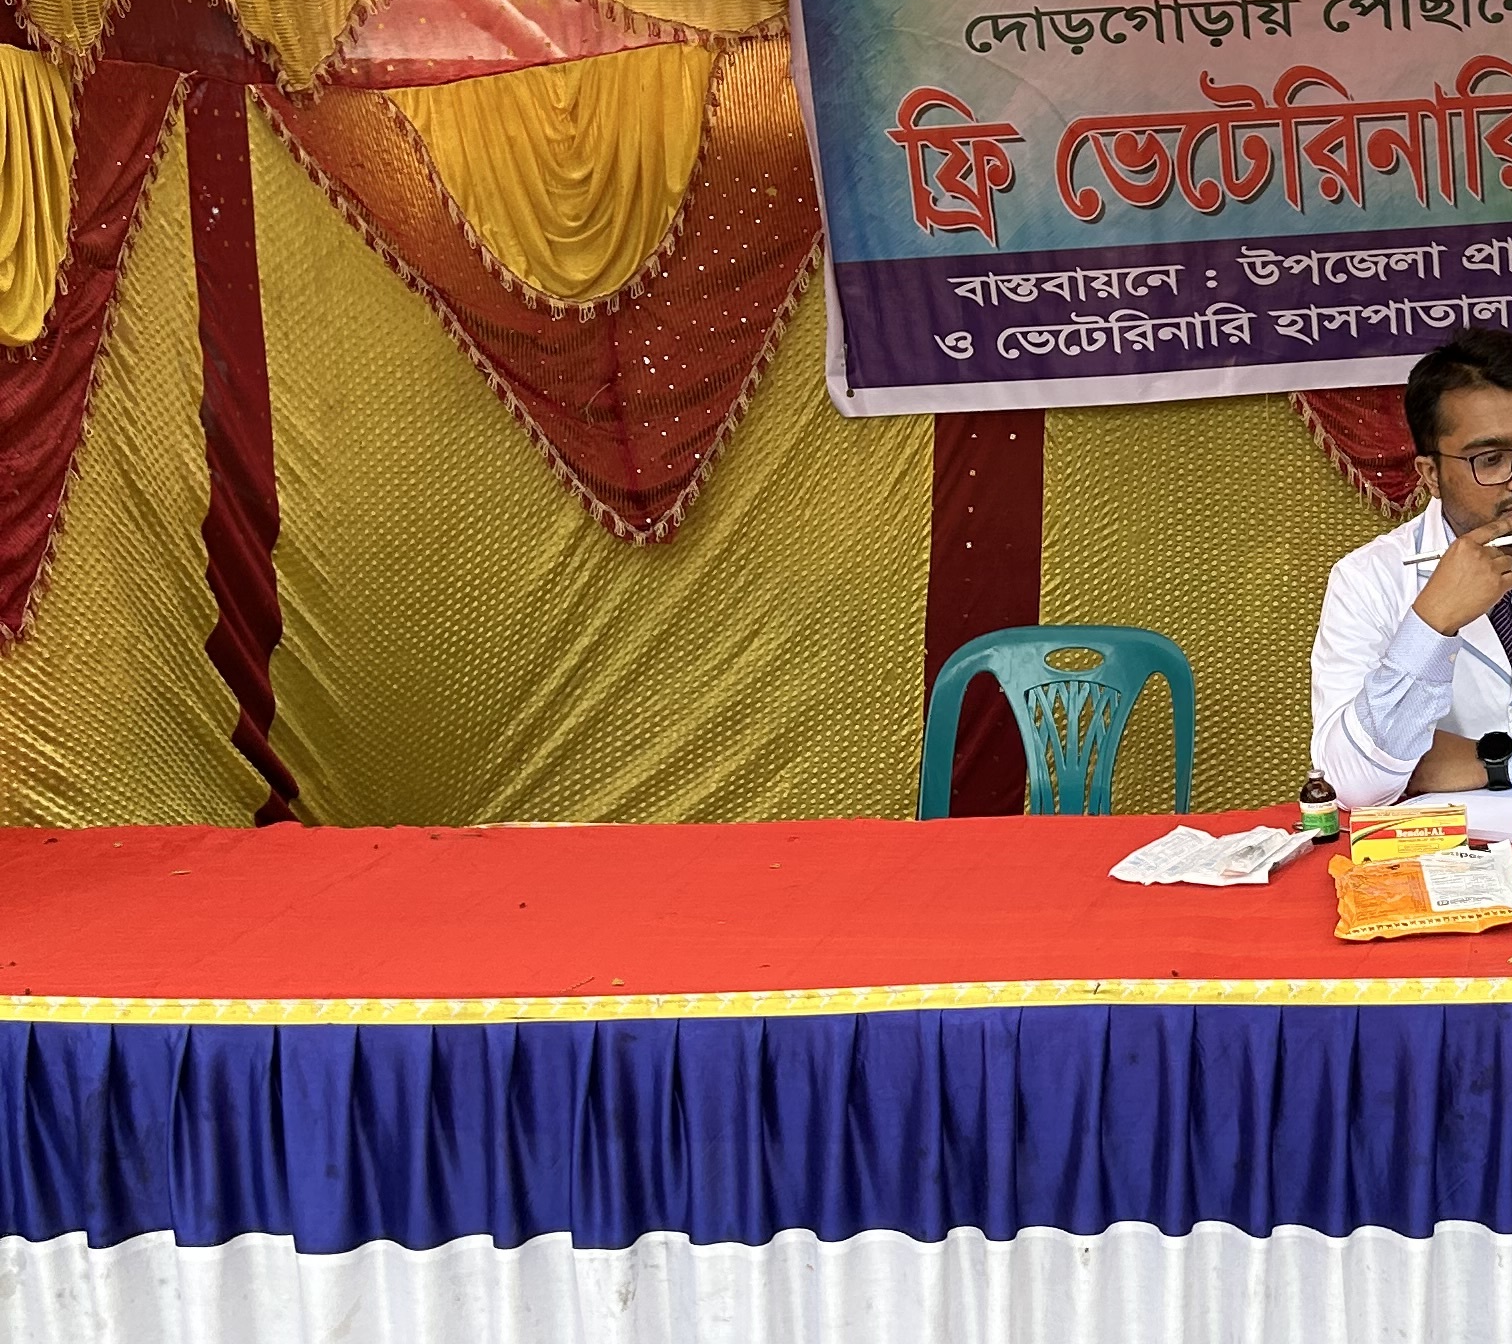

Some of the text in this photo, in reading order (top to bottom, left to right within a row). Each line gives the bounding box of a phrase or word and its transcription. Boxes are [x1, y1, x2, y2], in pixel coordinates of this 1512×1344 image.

[886, 86, 1027, 247] ফ্রি
[946, 265, 1186, 308] বাস্তবায়নে
[1235, 241, 1447, 287] উপজেলা
[934, 329, 975, 360] ও
[996, 307, 1257, 359] ভেটেরিনারি
